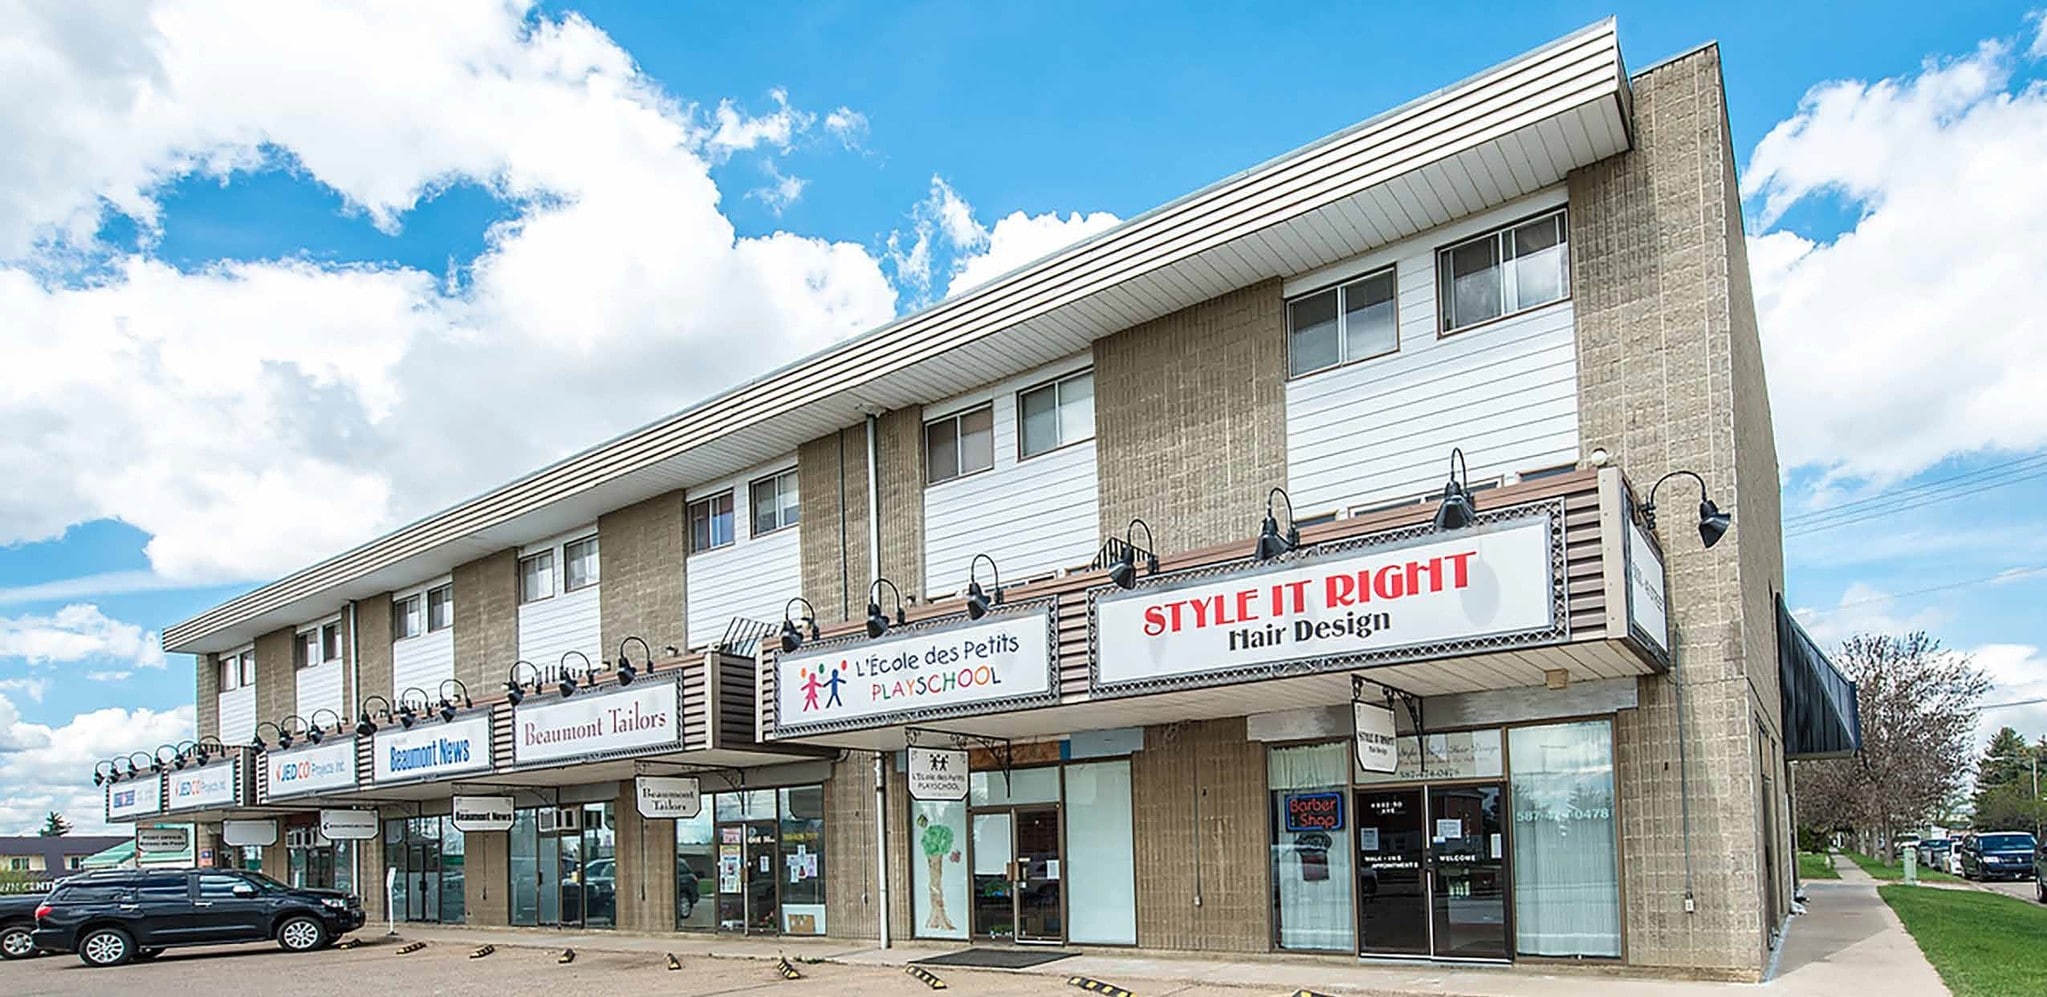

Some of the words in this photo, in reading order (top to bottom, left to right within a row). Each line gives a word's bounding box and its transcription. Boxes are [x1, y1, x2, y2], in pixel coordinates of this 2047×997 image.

[1143, 588, 1260, 637] STYLE
[1272, 579, 1312, 618] IT
[1325, 551, 1477, 609] RIGHT
[1229, 623, 1286, 651] Hair
[1295, 611, 1391, 642] Design
[856, 653, 920, 678] L'École
[925, 644, 960, 666] des
[964, 633, 1020, 660] Petits
[872, 665, 1002, 701] PLAYSCHOOL
[525, 717, 603, 747] Beaumont
[608, 701, 667, 735] Tailors
[390, 739, 437, 773] Beaumont
[439, 738, 470, 766] News
[281, 761, 311, 782] JEDCO
[642, 787, 694, 798] Beaumont
[918, 782, 961, 791] PLAYSCHOOL
[652, 799, 686, 811] Tailors
[1289, 798, 1336, 813] Barber
[456, 811, 490, 821] Beaumont
[492, 811, 512, 821] News
[1300, 813, 1335, 829] Shop
[1439, 854, 1476, 862] WELCOME
